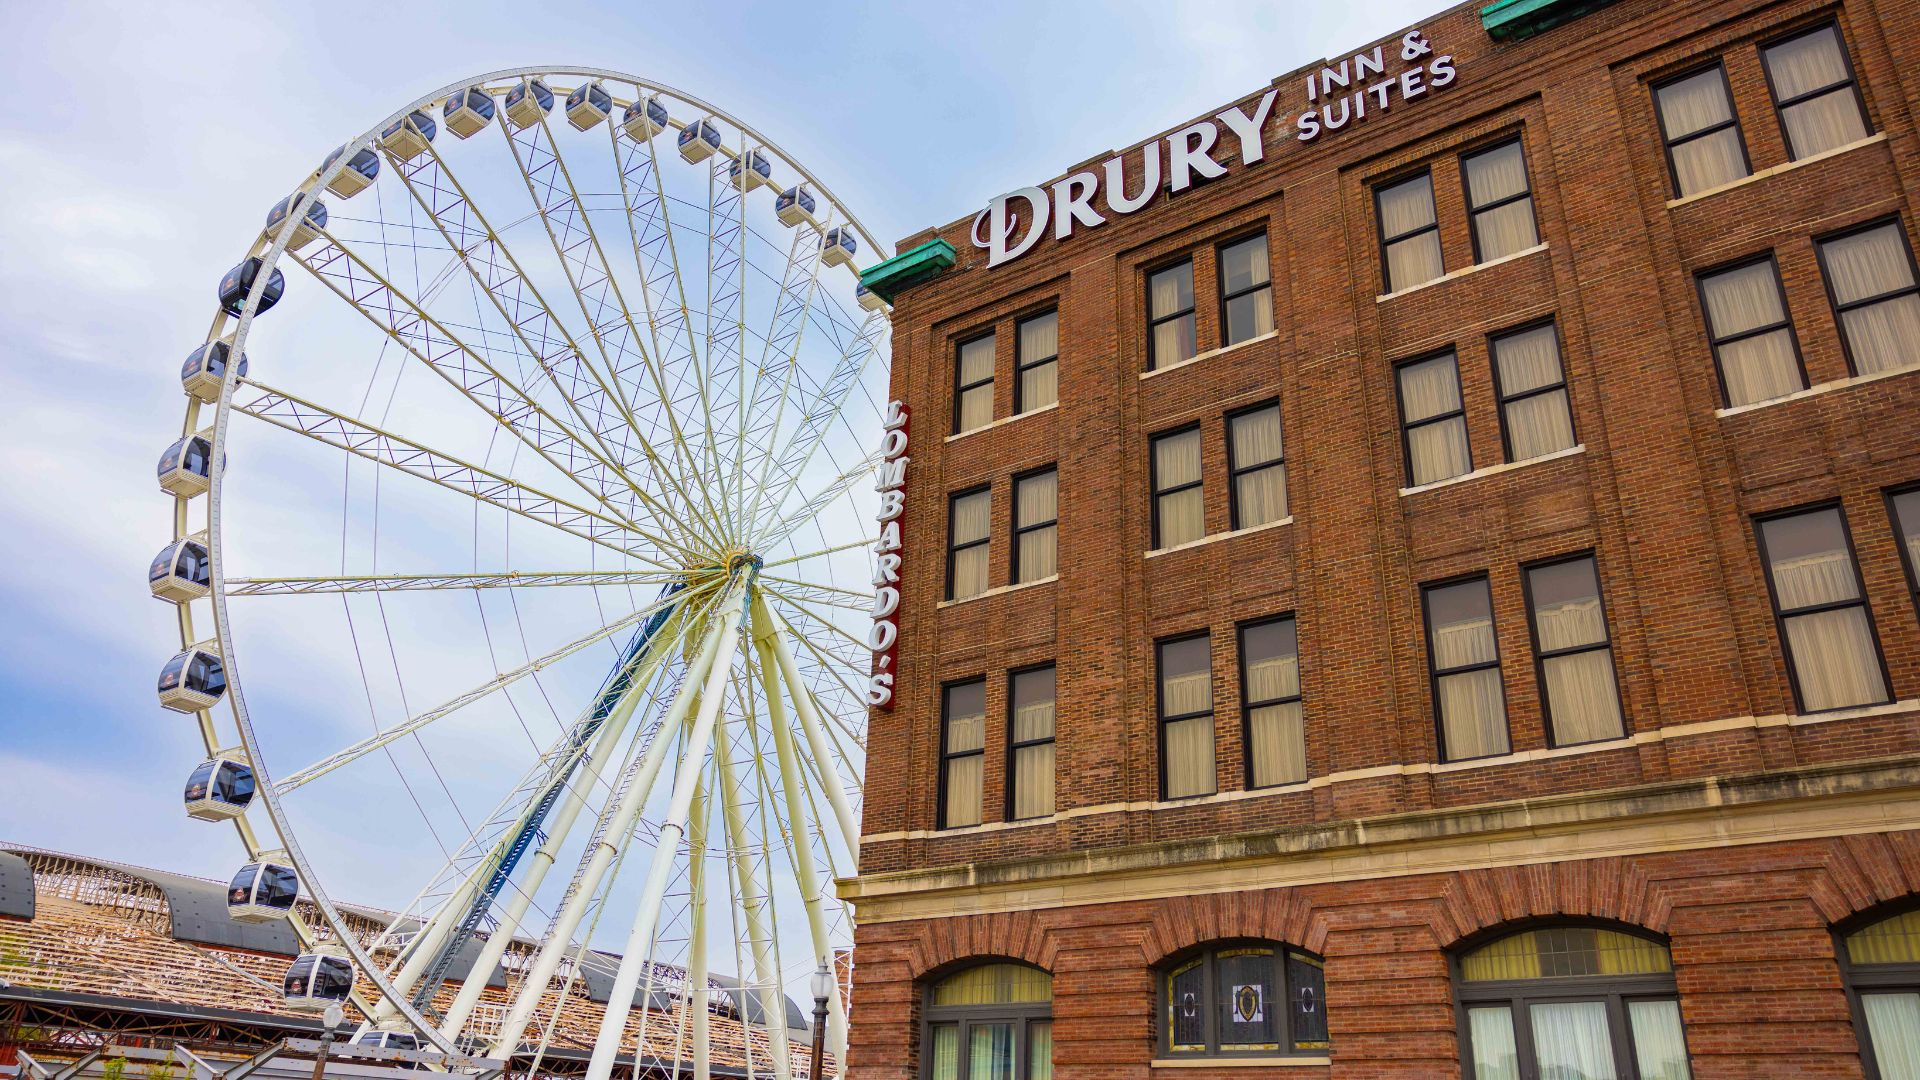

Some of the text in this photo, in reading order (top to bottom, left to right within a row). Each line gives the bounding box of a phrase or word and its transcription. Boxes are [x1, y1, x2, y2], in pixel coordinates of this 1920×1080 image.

[1297, 54, 1459, 142] SUITES
[1307, 30, 1434, 102] INN &
[970, 90, 1281, 270] DRURY
[867, 399, 910, 707] LOMBARDO'S
